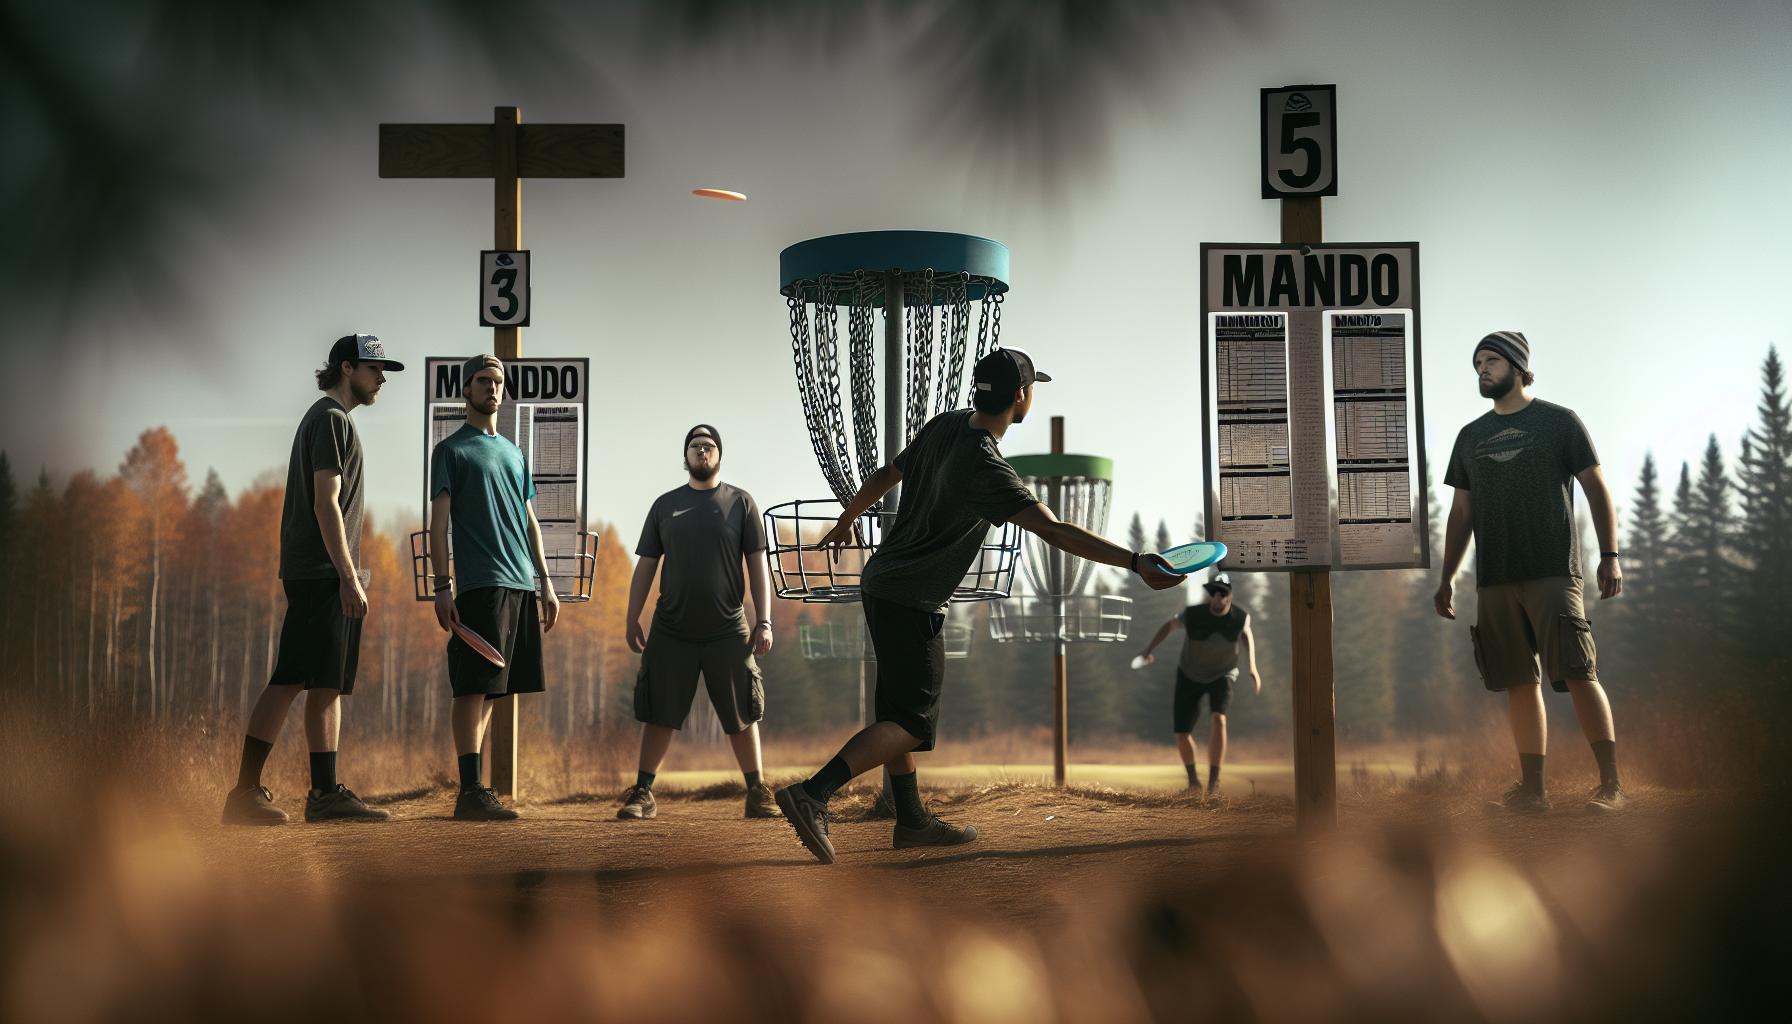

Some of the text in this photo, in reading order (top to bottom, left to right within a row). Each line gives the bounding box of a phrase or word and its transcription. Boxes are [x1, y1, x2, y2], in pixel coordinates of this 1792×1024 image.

[1278, 112, 1321, 188] 5
[490, 268, 519, 321] 3
[1223, 253, 1399, 307] MANDO
[435, 365, 578, 400] MNDDO
